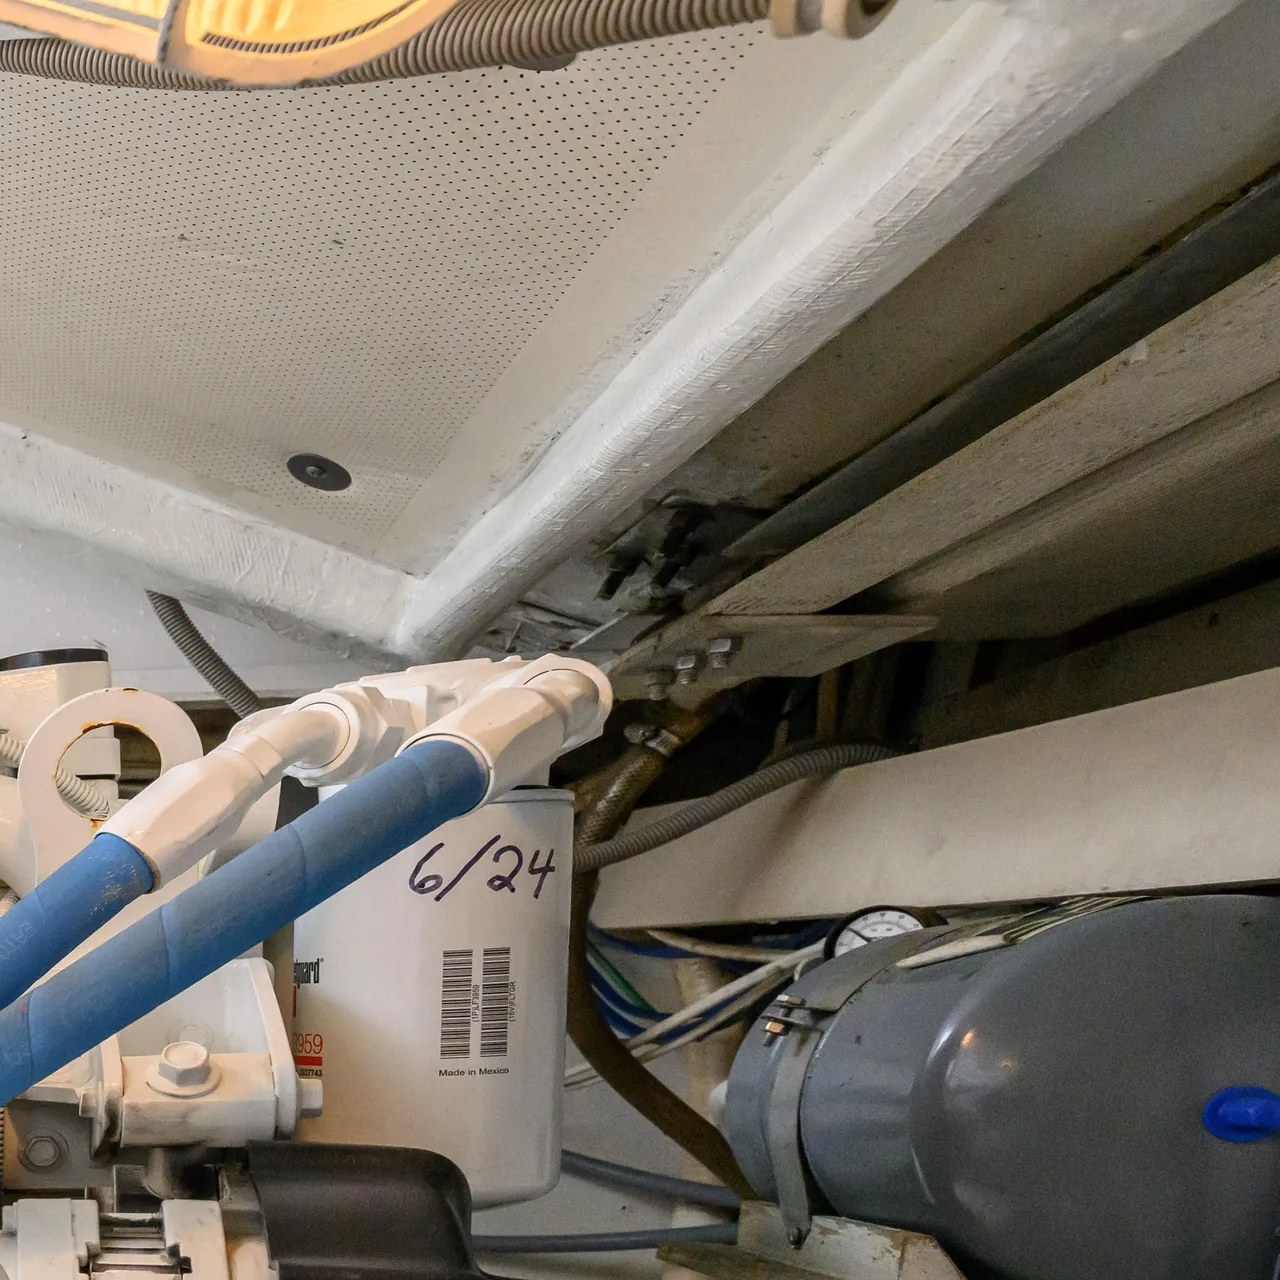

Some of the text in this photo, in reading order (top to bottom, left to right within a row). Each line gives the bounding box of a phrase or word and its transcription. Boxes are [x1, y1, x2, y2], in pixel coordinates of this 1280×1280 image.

[409, 834, 555, 901] 6/24
[471, 985, 481, 1022] (1P)LF3959
[439, 1067, 509, 1077] Made in Mexico
